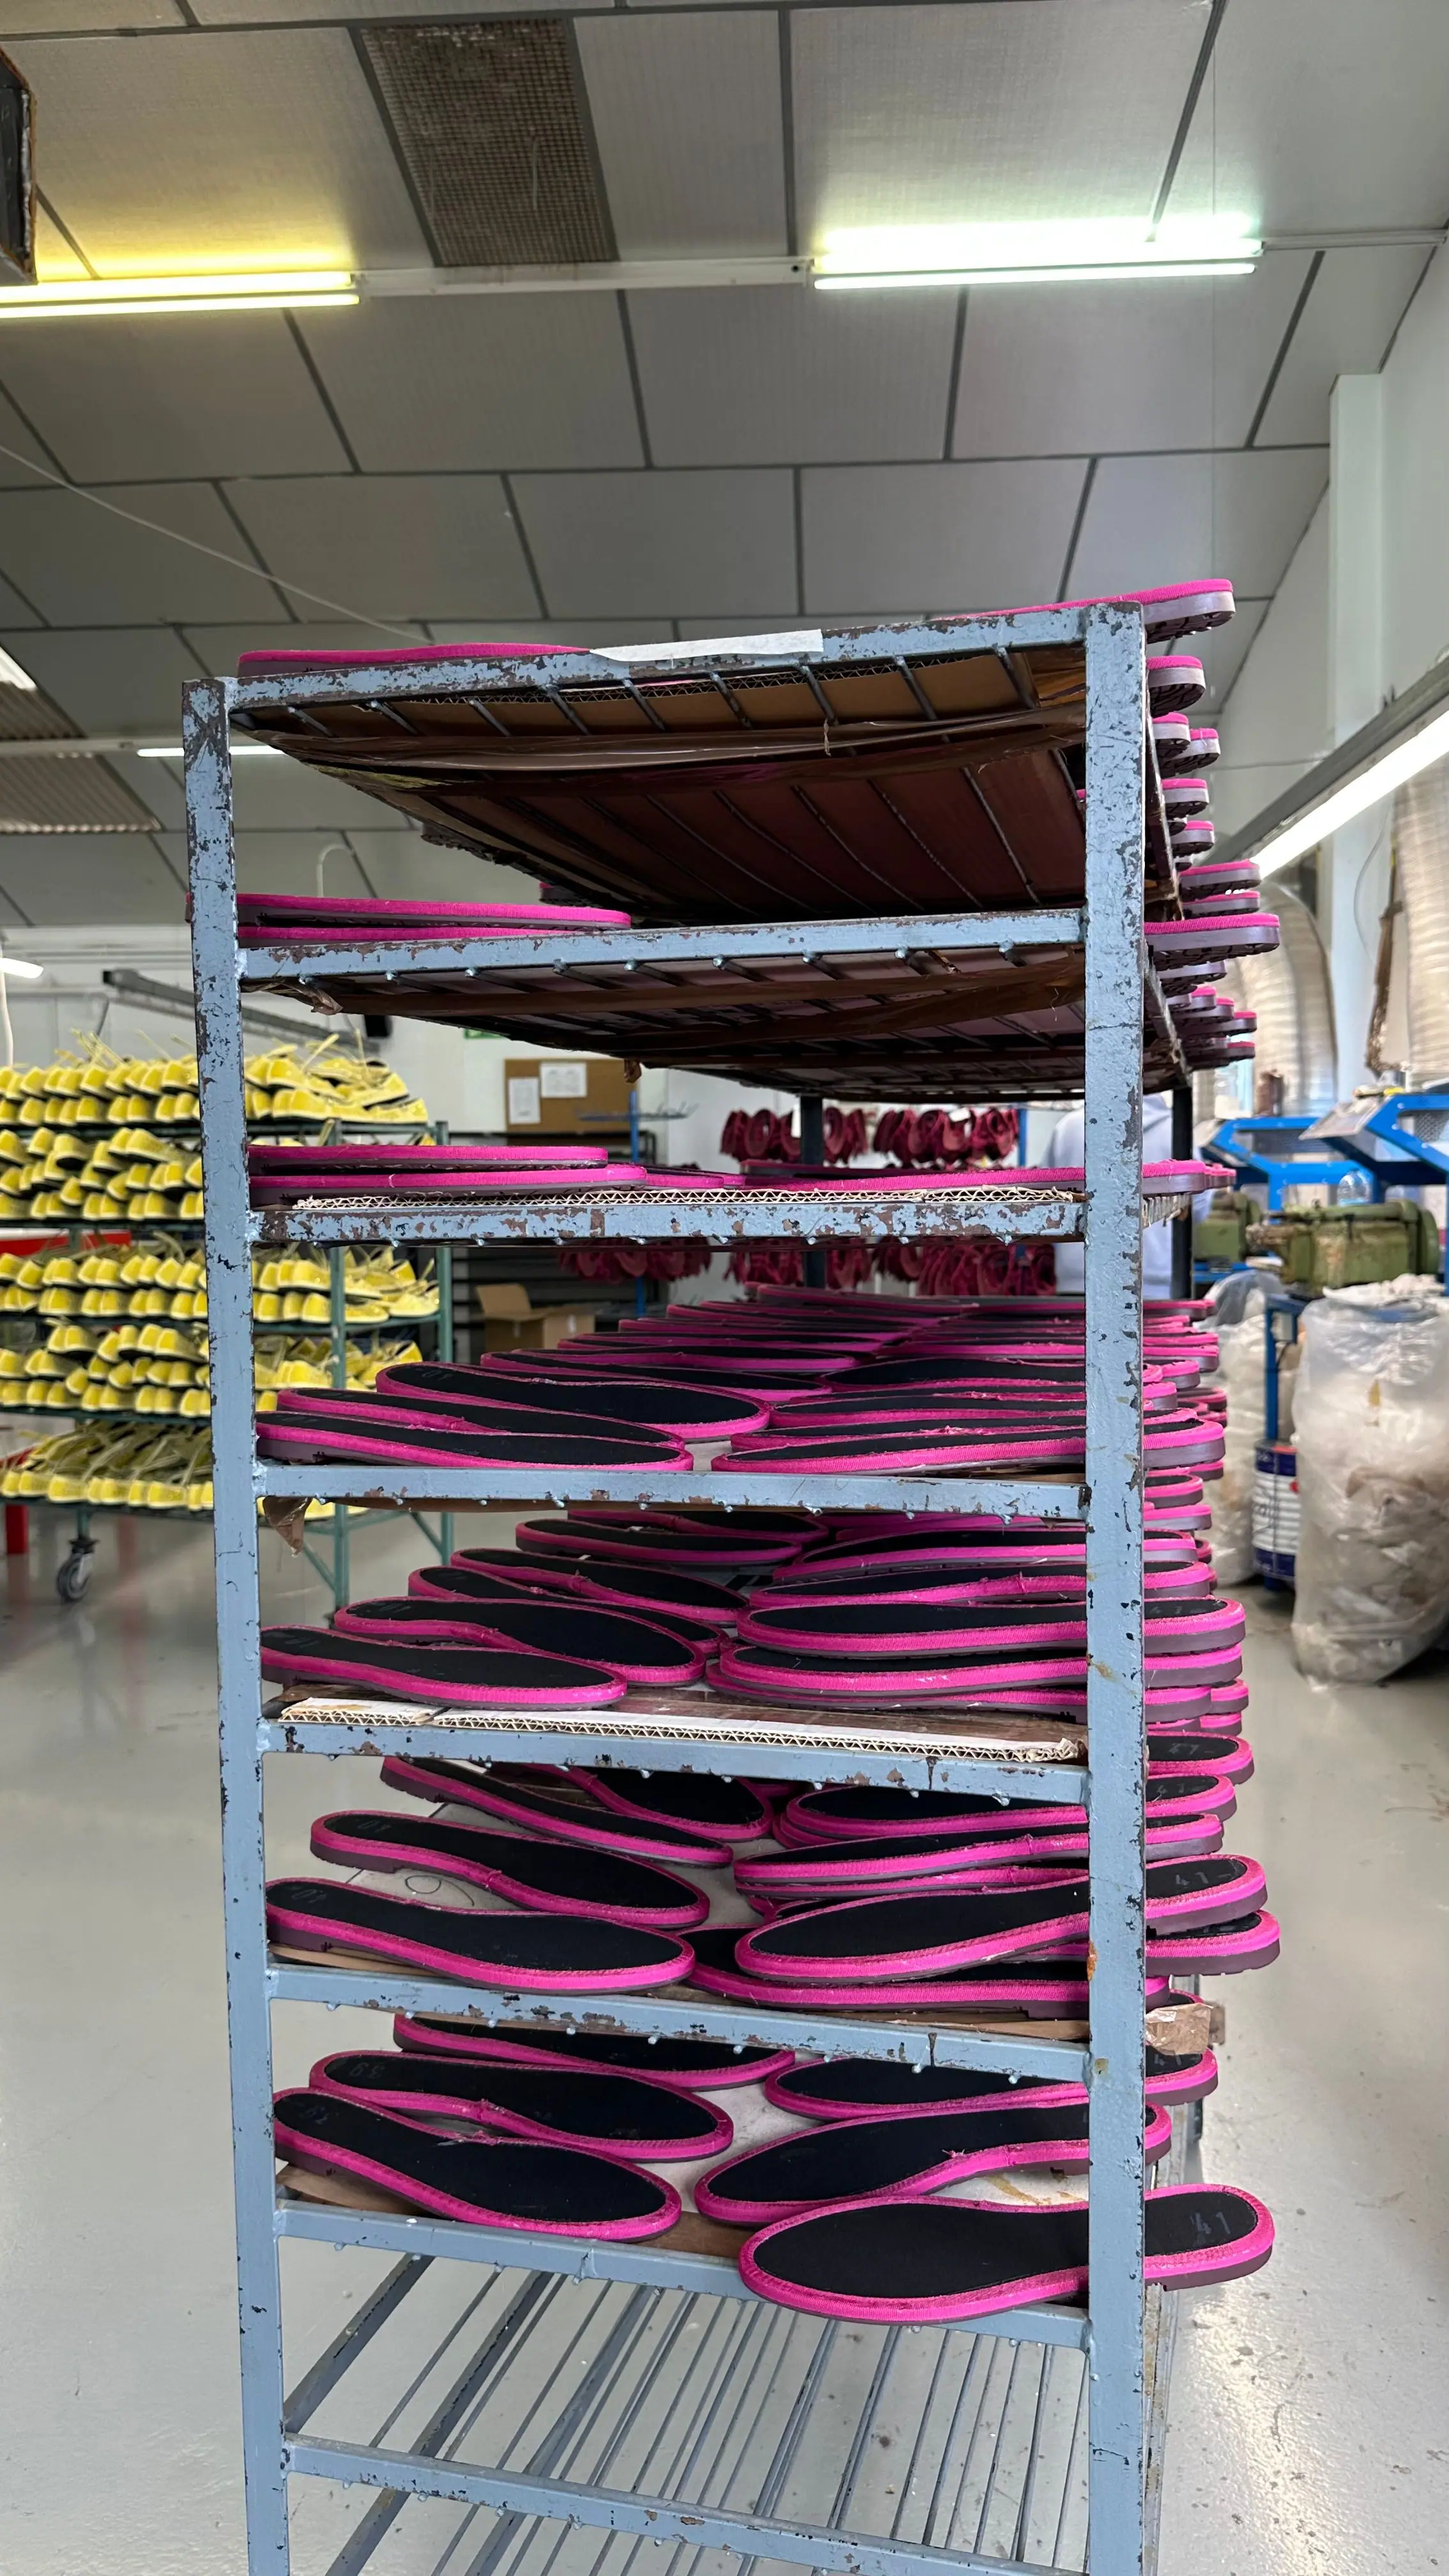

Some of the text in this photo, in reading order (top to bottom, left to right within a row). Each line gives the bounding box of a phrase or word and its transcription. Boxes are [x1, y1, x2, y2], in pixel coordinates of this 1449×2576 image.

[1175, 1871, 1209, 1886] 41
[349, 2062, 385, 2080] 39
[1189, 2211, 1231, 2235] 41
